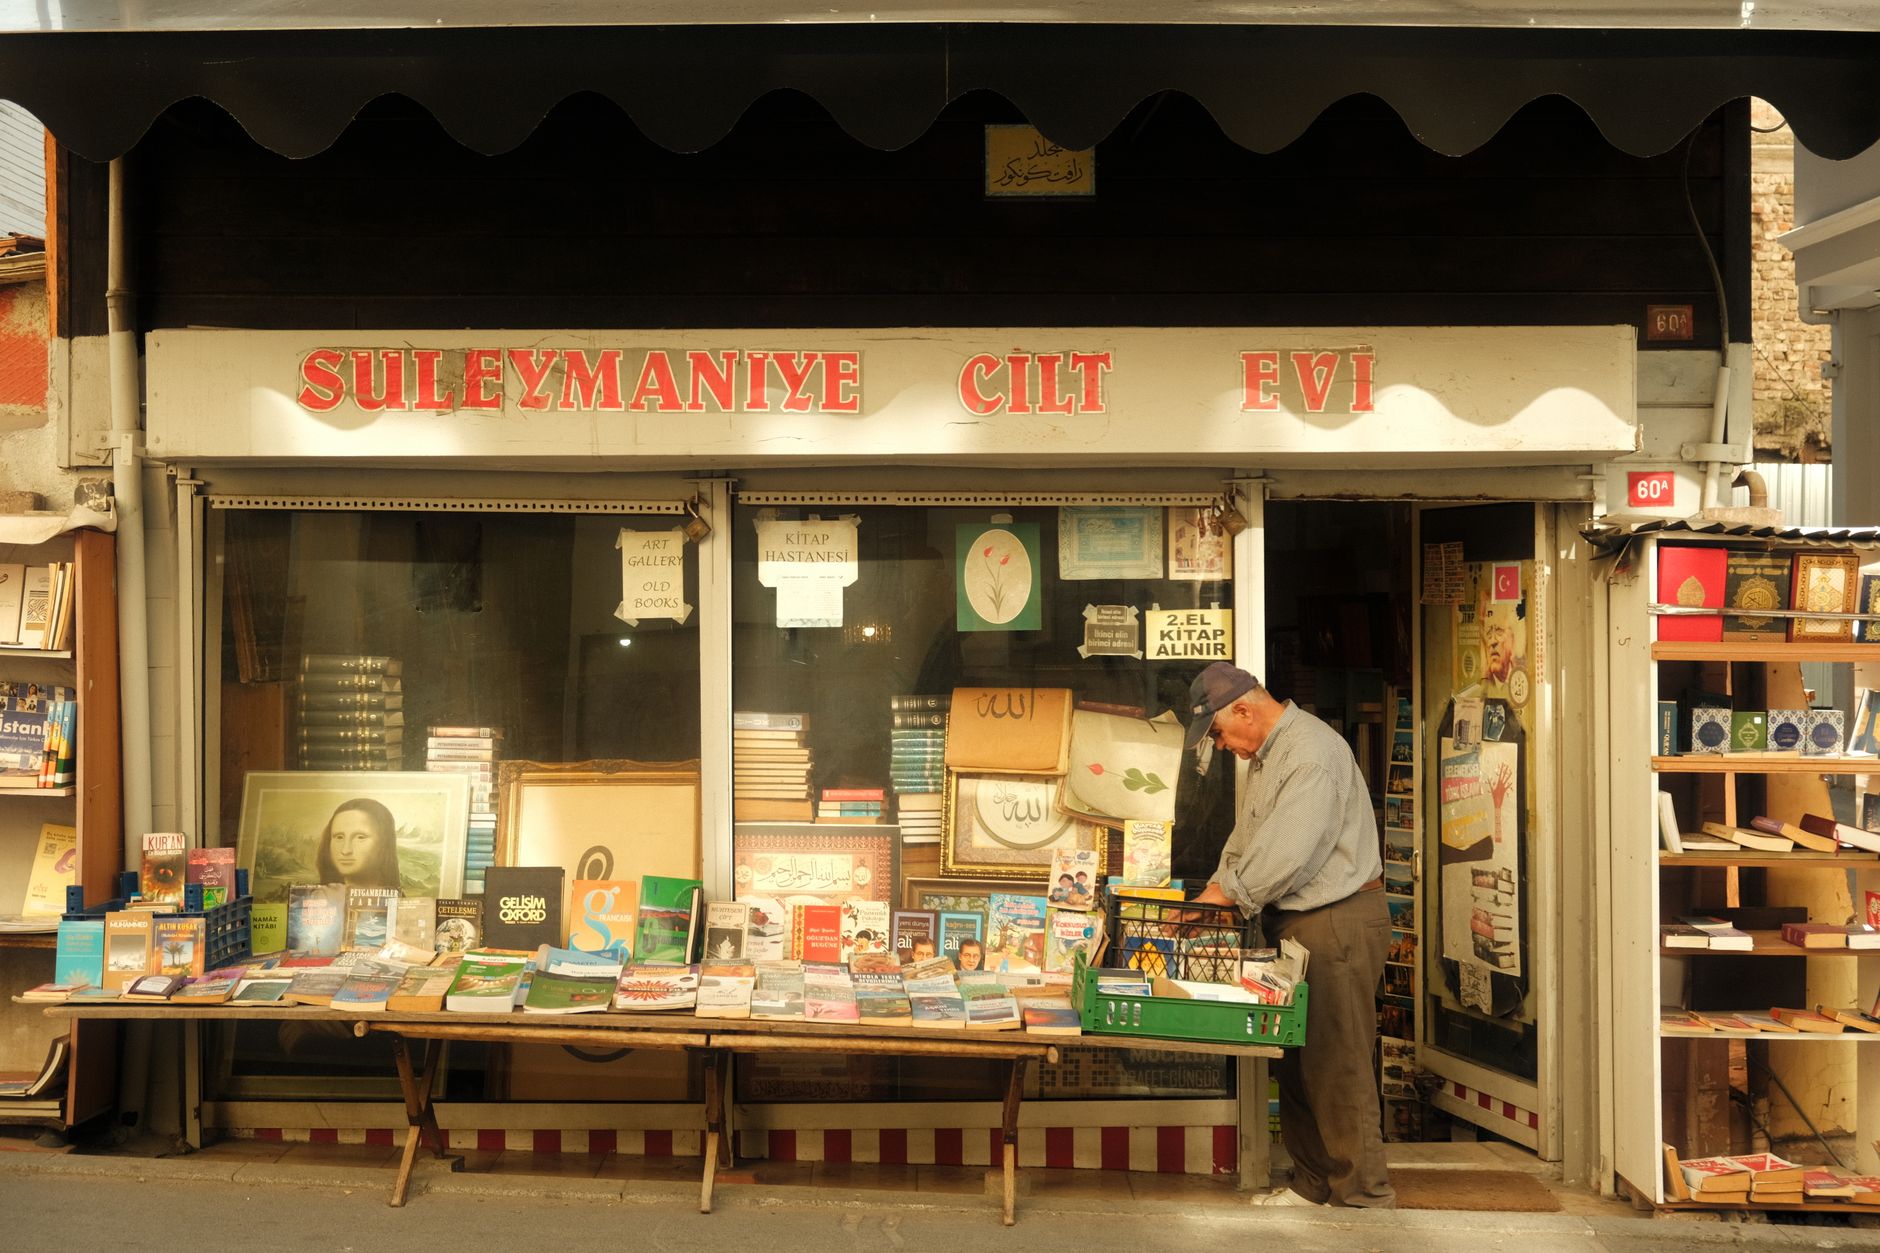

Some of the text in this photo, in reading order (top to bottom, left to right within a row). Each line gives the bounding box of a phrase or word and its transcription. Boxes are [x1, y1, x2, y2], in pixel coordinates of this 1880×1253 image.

[1656, 314, 1687, 332] 60A
[1637, 479, 1668, 499] 60A
[642, 539, 671, 551] ART
[785, 532, 830, 546] KİTAP
[628, 555, 684, 568] GALLERY
[765, 549, 849, 564] HASTANESİ
[642, 580, 671, 593] OLD
[634, 597, 679, 609] BOOKS
[1167, 613, 1211, 626] 2.EL
[1159, 626, 1225, 641] KİTAP
[1155, 642, 1227, 656] ALINIR
[148, 836, 183, 851] KUR'AN
[500, 895, 546, 910] GELİŞİM
[438, 906, 477, 917] ÇETELEŞME
[499, 909, 546, 922] OXFORD
[897, 935, 912, 949] ali
[944, 937, 959, 951] ali
